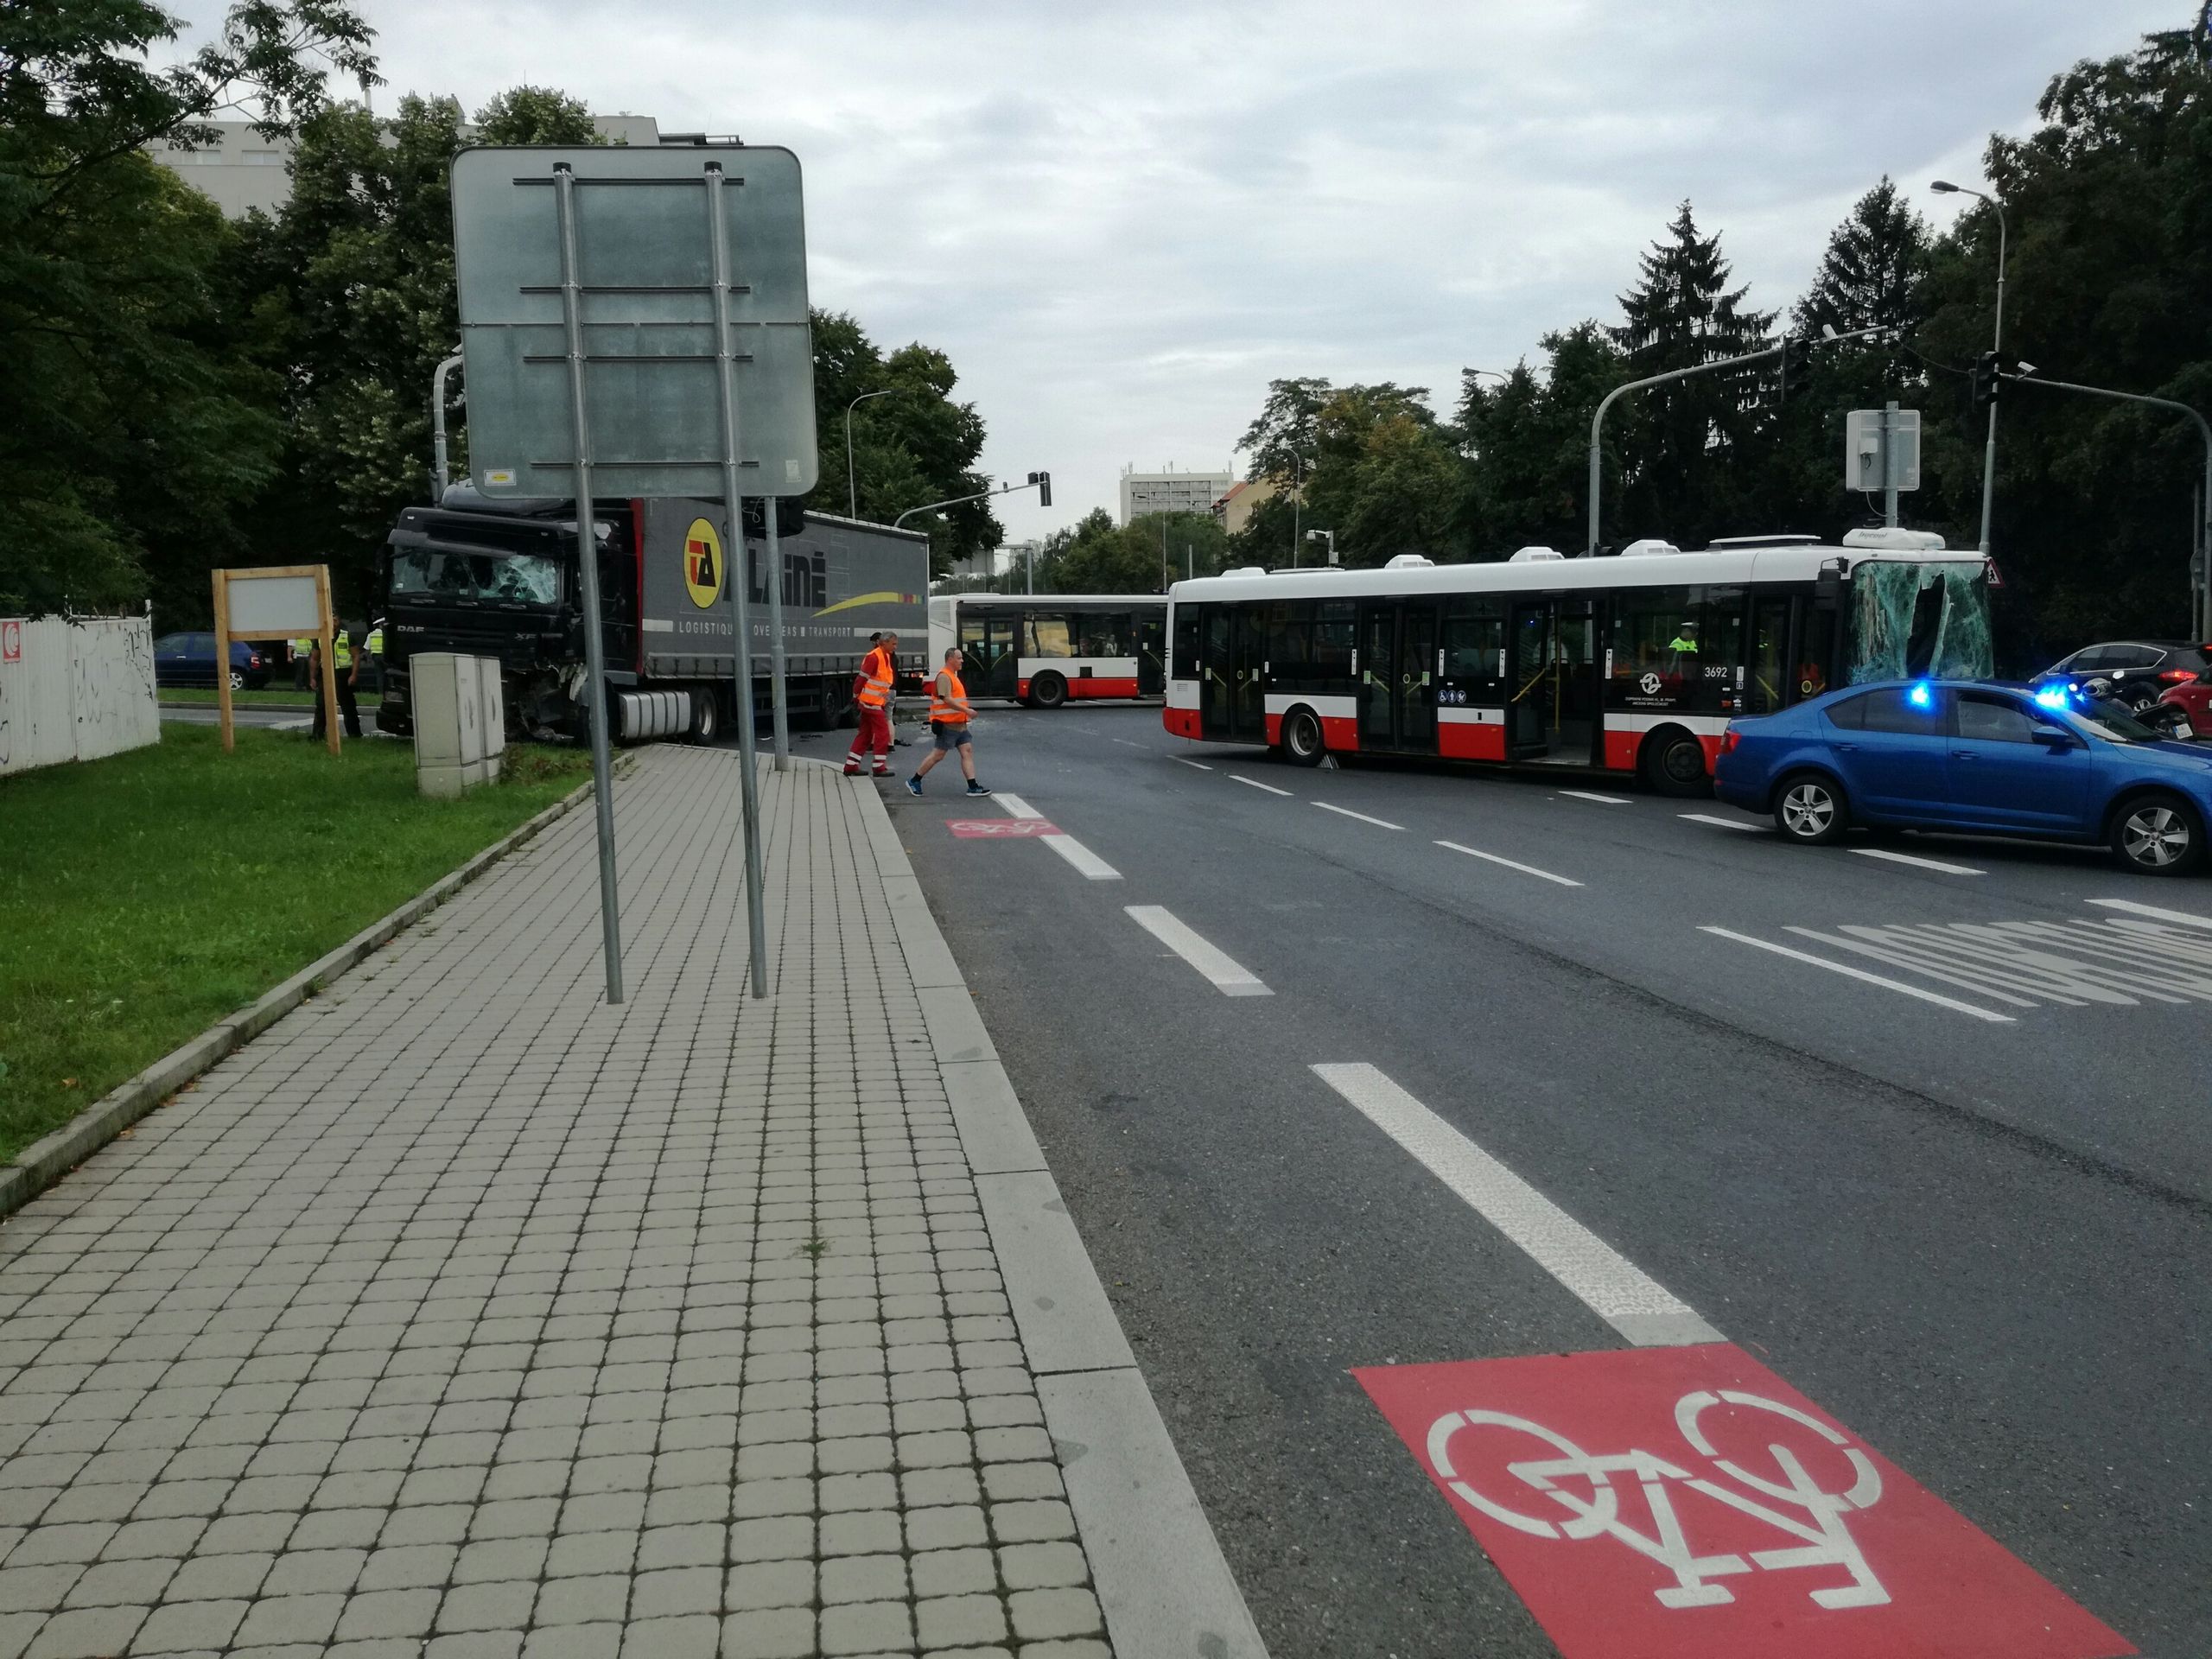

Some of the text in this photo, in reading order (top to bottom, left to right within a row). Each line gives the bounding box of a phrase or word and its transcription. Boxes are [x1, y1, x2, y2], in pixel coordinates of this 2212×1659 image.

[679, 621, 851, 638] LOGISTIQU OVEEAS TRANSPORT
[1704, 666, 1727, 678] 3692
